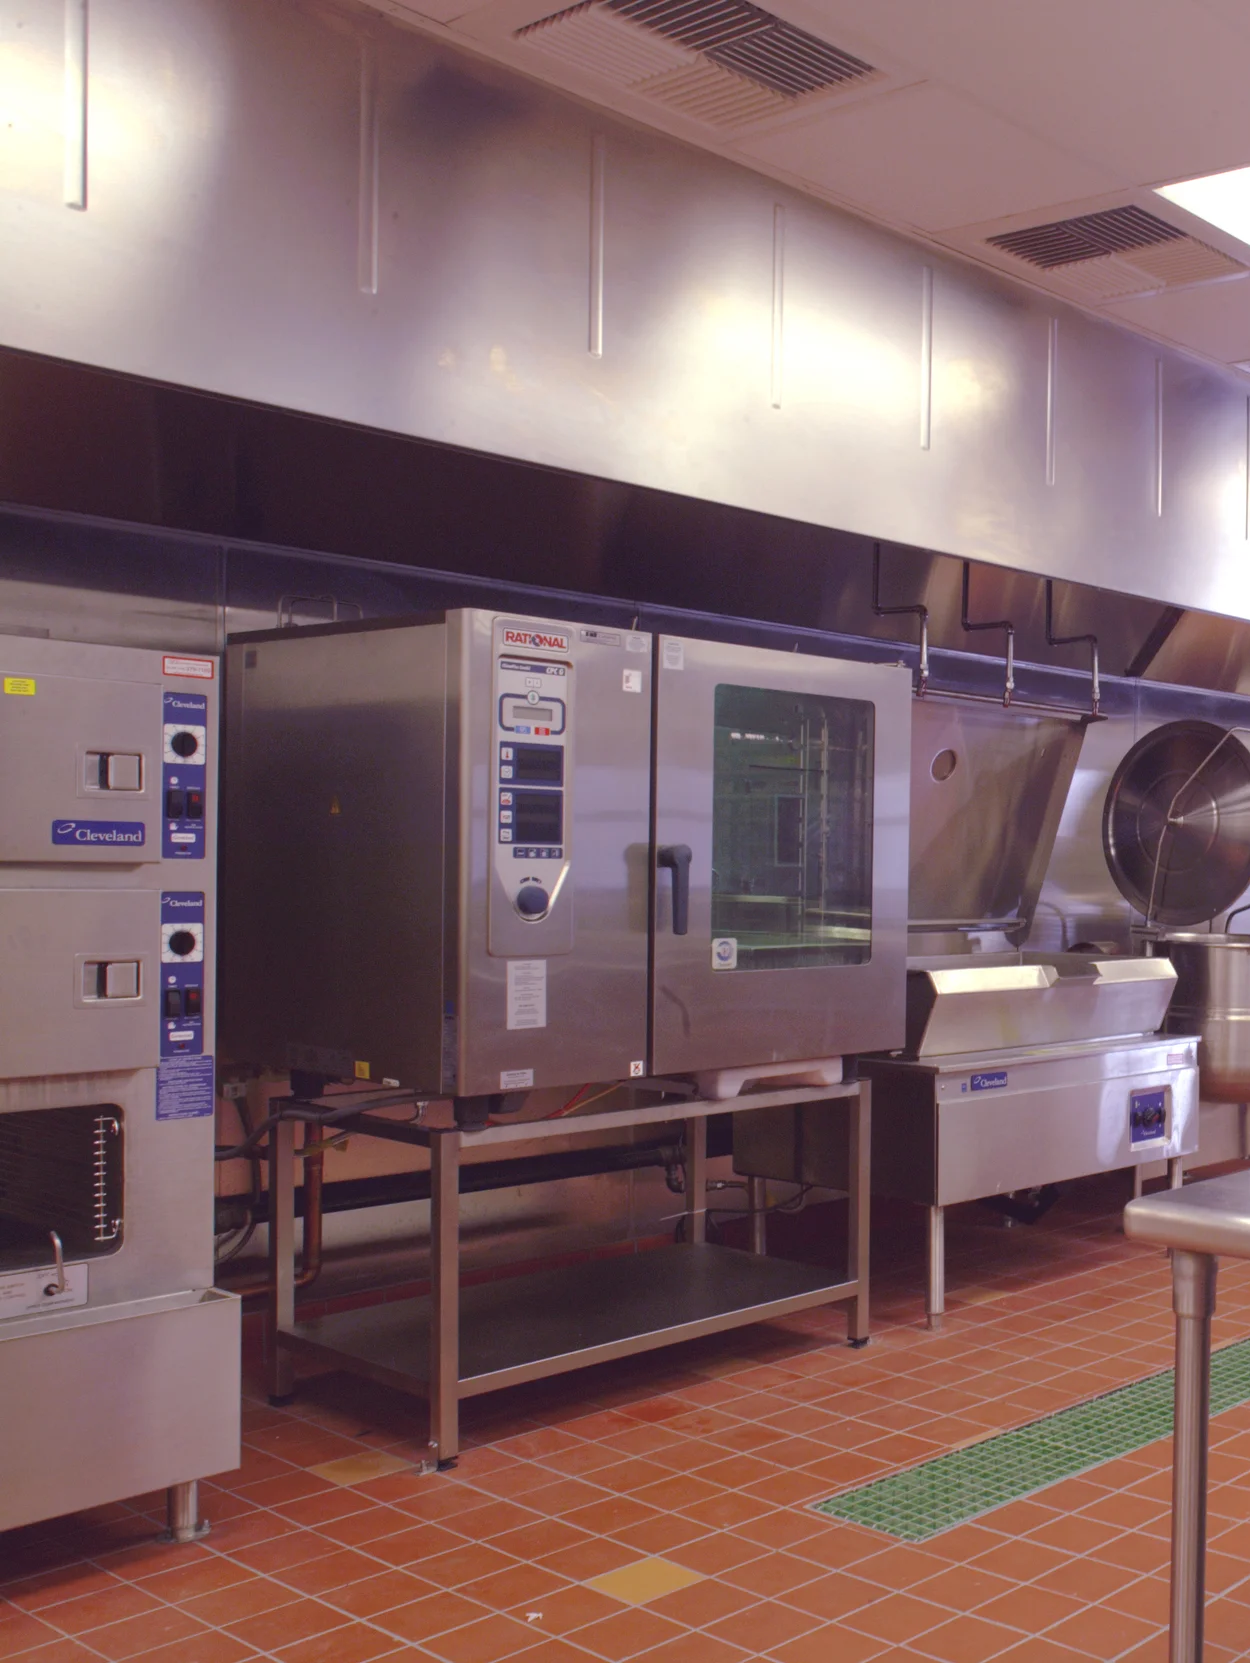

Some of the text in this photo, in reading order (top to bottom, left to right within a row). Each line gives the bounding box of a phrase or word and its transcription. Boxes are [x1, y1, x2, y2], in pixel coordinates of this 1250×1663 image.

[505, 631, 566, 649] RATIONAL
[172, 700, 206, 710] Cleveland
[75, 828, 142, 842] Cleveland
[169, 899, 203, 907] Cleveland
[980, 1076, 1007, 1088] Cleveland
